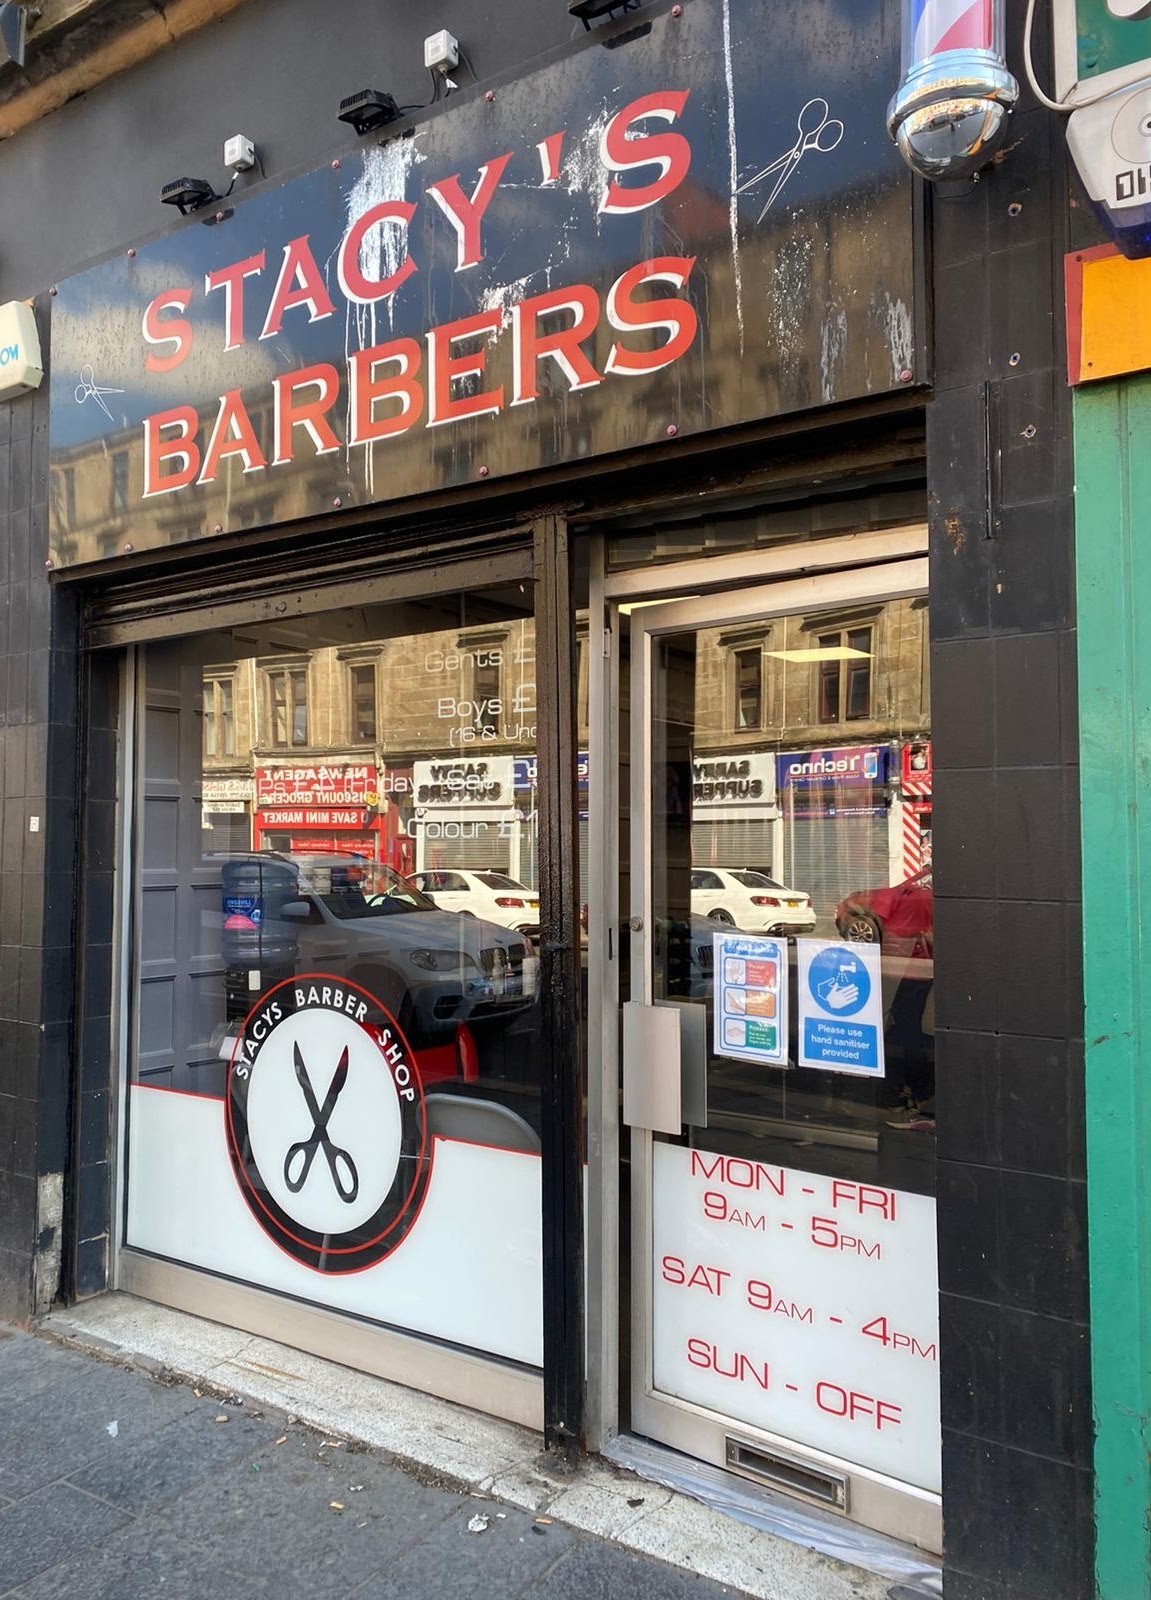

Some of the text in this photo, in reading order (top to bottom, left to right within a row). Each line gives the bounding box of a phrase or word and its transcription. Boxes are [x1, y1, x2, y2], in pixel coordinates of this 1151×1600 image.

[142, 88, 693, 374] STACY'S
[142, 255, 698, 499] BARBERS
[424, 648, 504, 673] Gents
[437, 697, 503, 723] Boys
[449, 726, 476, 748] (16
[481, 725, 498, 742] &
[446, 768, 496, 791] Sat
[407, 818, 488, 839] Colour
[236, 986, 415, 1101] STACYS BARBER SHOP
[811, 1034, 870, 1050] hand sanitiser
[817, 1023, 863, 1038] Please use
[822, 1048, 859, 1060] provided
[691, 1151, 785, 1197] MON
[832, 1180, 896, 1221] FRI
[703, 1191, 766, 1231] 9AM
[811, 1216, 881, 1260] 5PM
[662, 1256, 731, 1296] SAT
[747, 1280, 813, 1324] 9AM
[862, 1317, 936, 1361] 4PM
[687, 1338, 769, 1390] SUN
[816, 1381, 902, 1430] OFF
